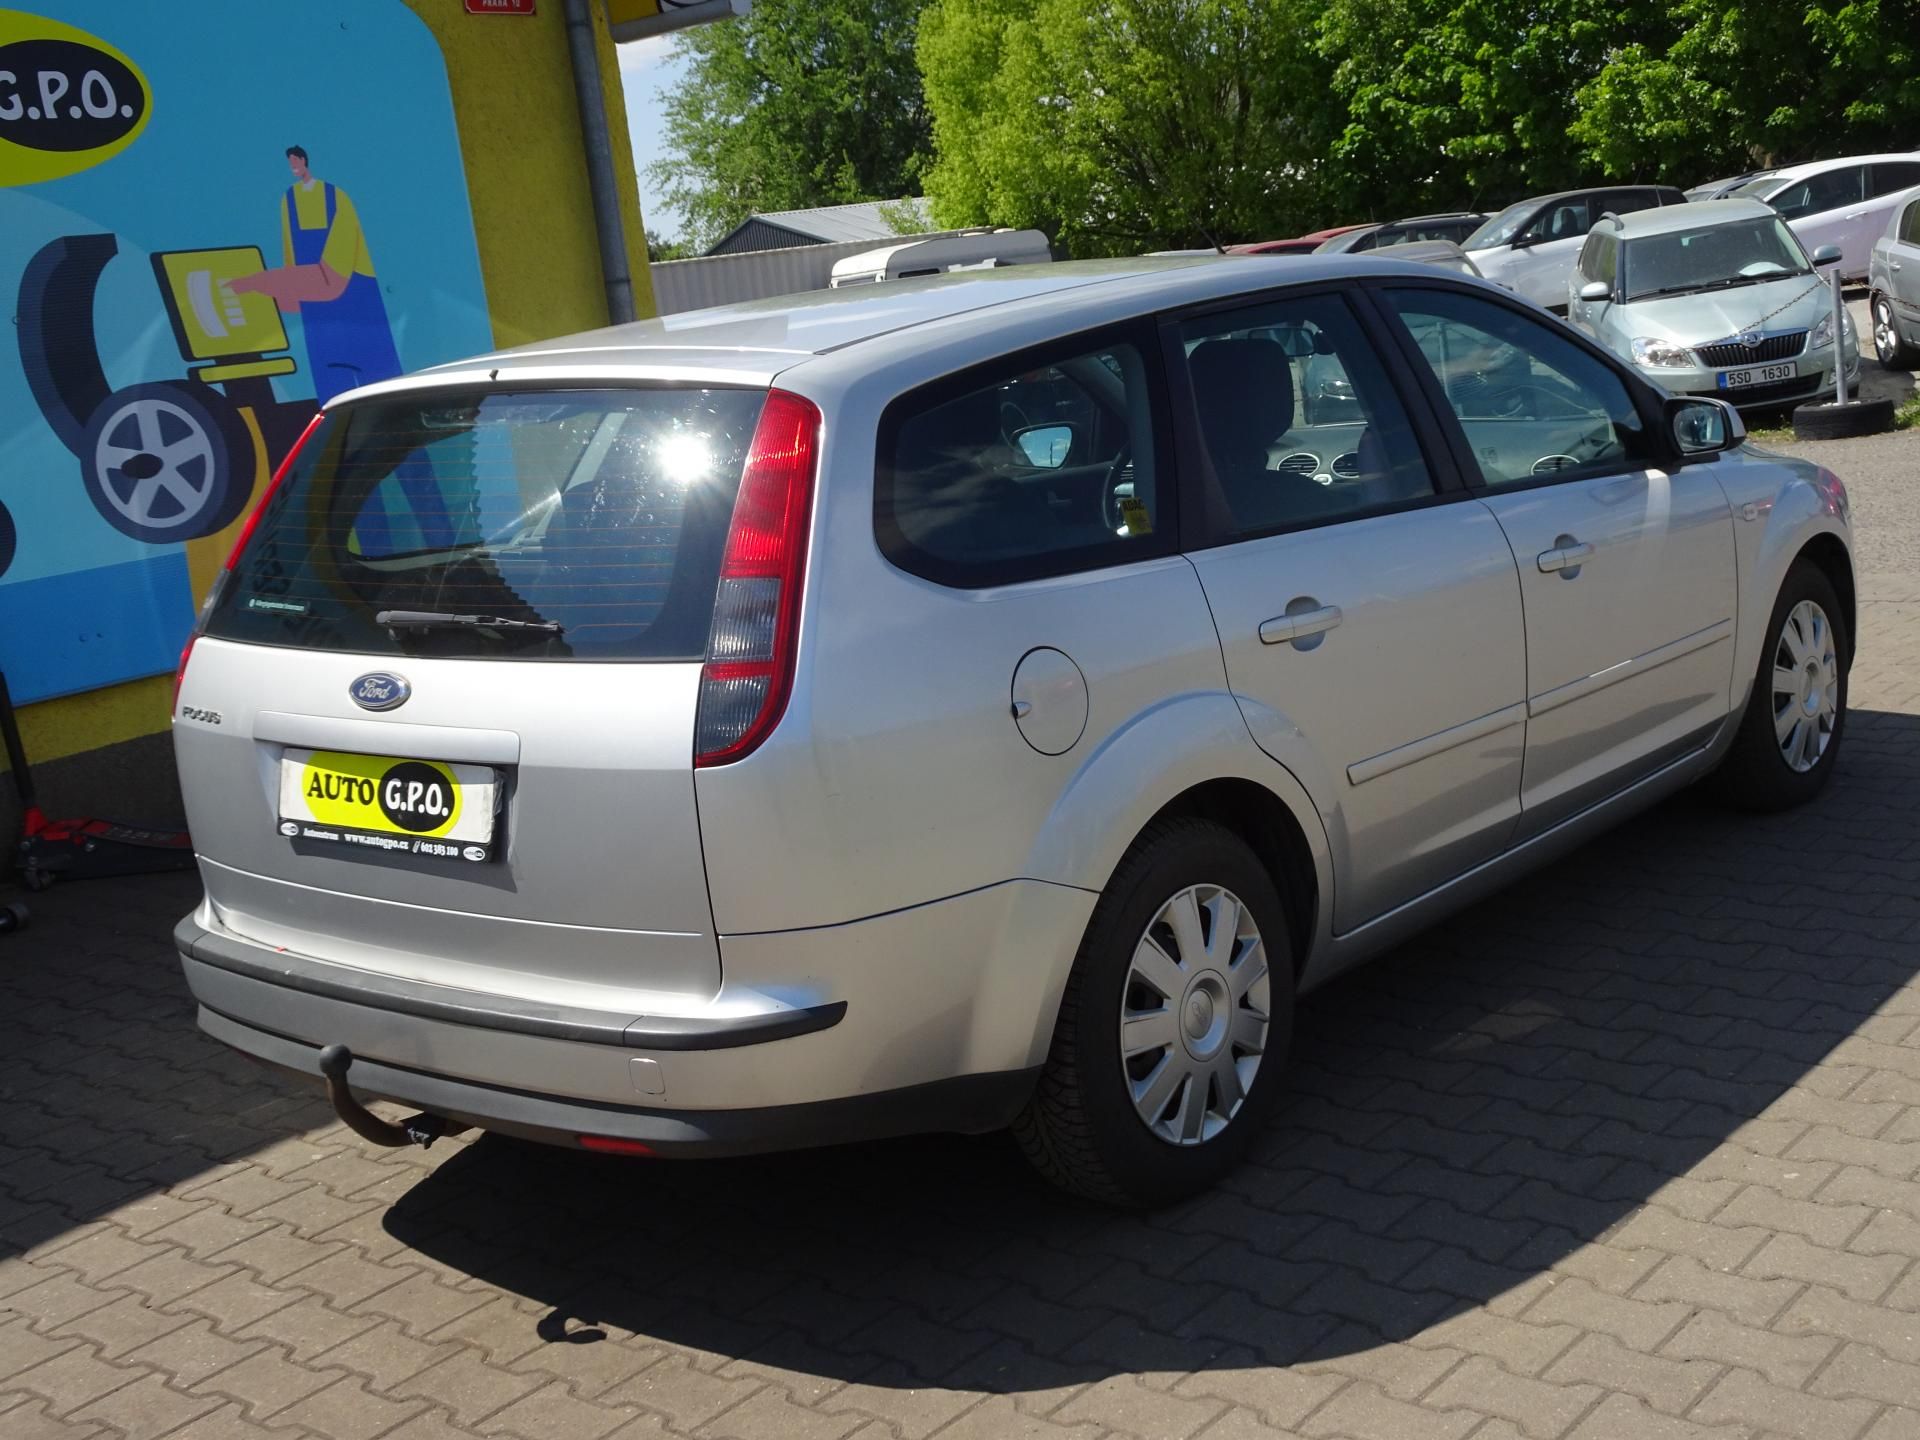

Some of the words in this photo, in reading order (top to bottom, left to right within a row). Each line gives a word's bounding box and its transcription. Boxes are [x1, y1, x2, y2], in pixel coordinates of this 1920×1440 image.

[1728, 371, 1752, 386] 5SD
[1761, 365, 1790, 381] 1630
[359, 678, 392, 699] Ford
[182, 706, 221, 725] FOCUS
[306, 771, 375, 806] AUTO
[385, 778, 450, 817] G.P.O.
[343, 833, 409, 850] www.autogpo.cz
[446, 846, 459, 857] 100
